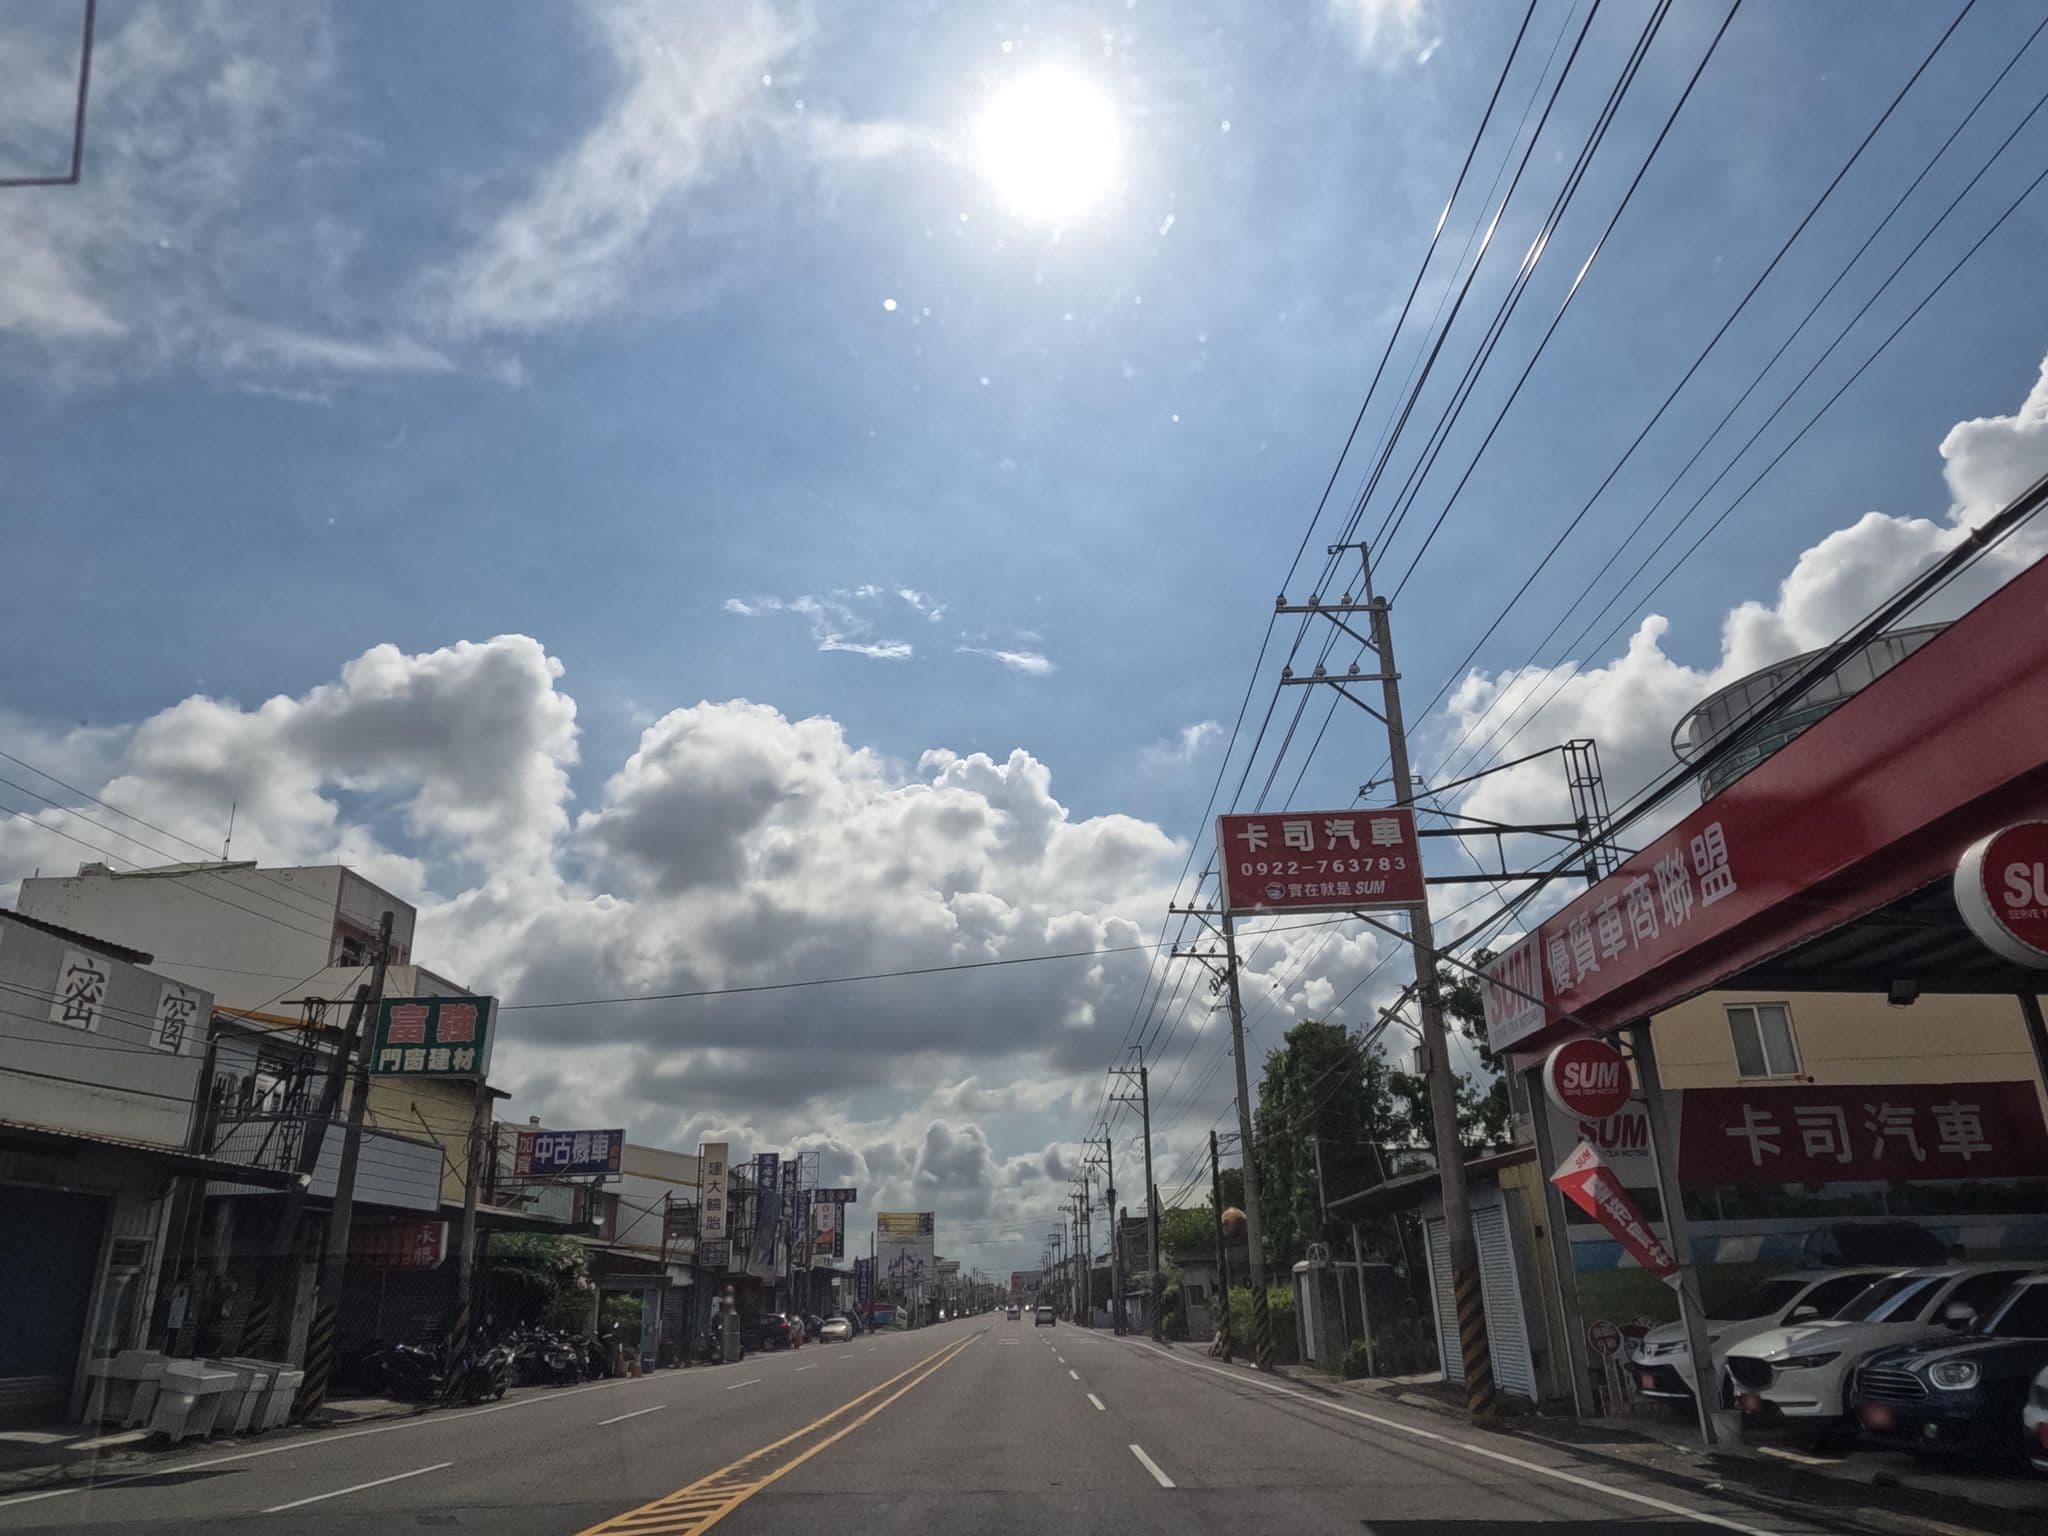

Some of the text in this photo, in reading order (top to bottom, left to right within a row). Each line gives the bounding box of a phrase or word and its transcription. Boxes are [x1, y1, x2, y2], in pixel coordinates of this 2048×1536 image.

[1237, 817, 1404, 853] 卡司汽車
[1241, 857, 1406, 876] 0922-763783
[1355, 881, 1385, 895] SUM
[1546, 821, 1737, 996] 優質車商聯盟
[387, 1003, 479, 1044] 富強
[1563, 1062, 1619, 1088] SUM
[535, 1133, 609, 1164] 中古機車
[1726, 1101, 1992, 1165] 卡司汽車
